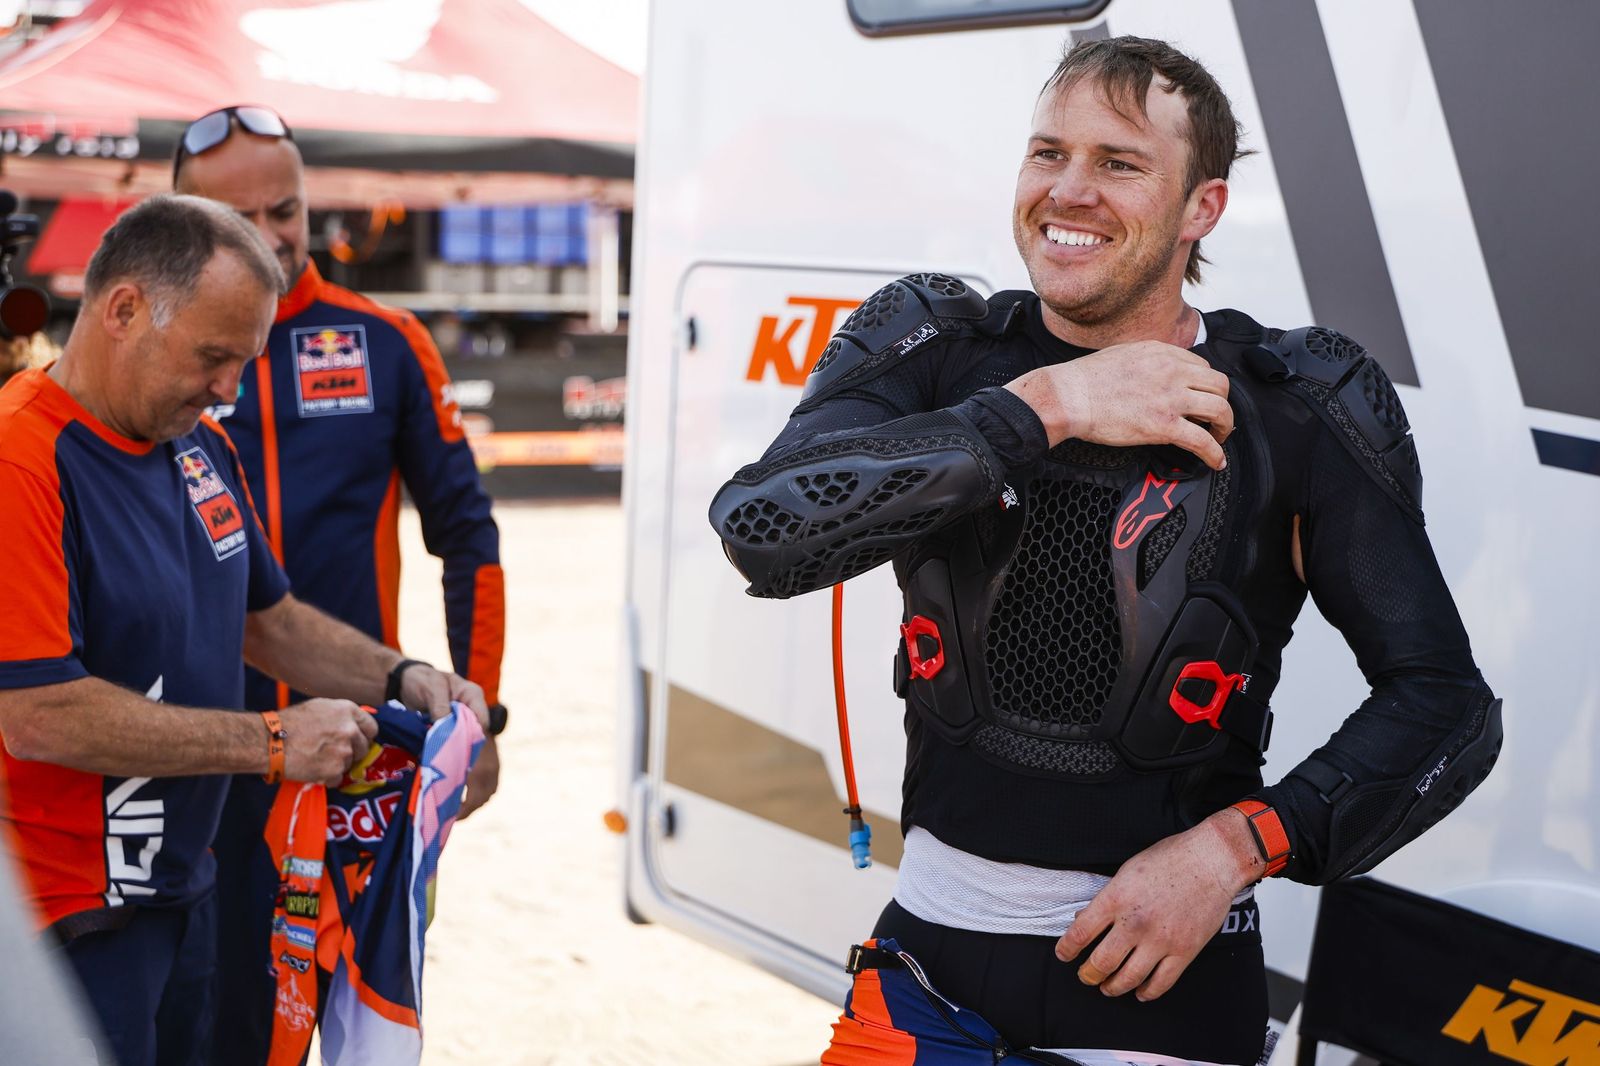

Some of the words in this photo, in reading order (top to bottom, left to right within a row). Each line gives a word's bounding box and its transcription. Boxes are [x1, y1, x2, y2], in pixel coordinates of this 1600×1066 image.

[744, 296, 863, 387] KT
[298, 351, 331, 372] Red
[332, 348, 365, 369] Bull
[211, 506, 236, 529] KTM
[326, 799, 386, 843] ed
[1221, 909, 1256, 934] OX
